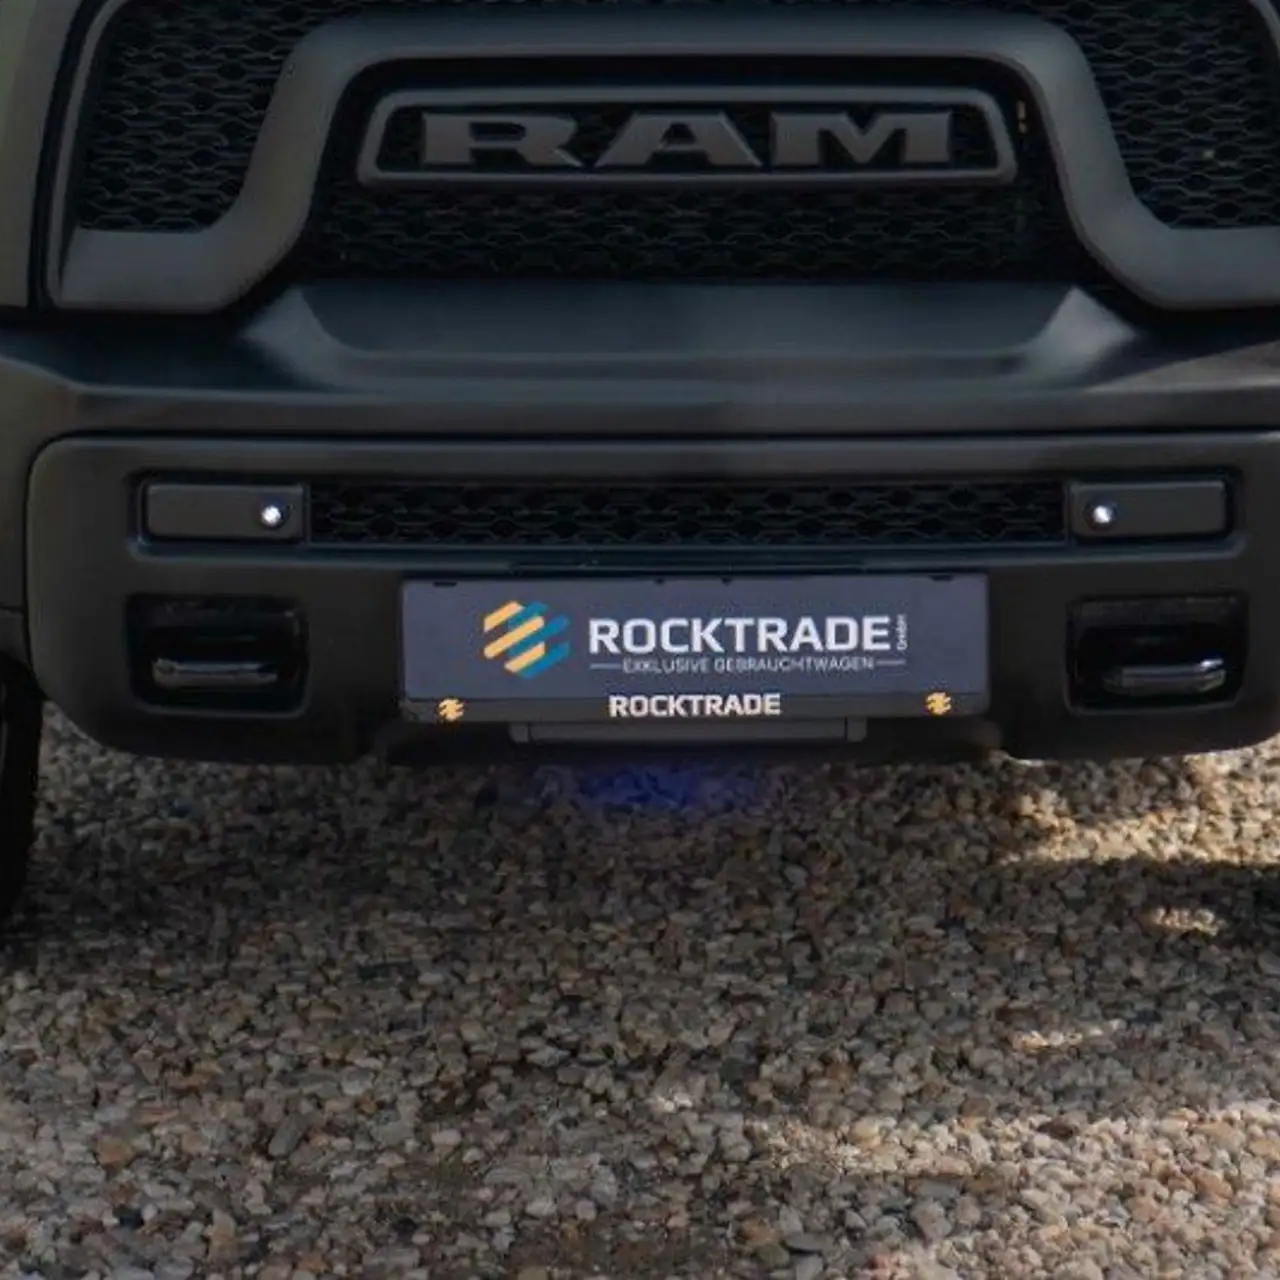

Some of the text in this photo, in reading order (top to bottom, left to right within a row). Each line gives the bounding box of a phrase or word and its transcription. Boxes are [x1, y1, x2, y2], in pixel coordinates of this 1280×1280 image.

[422, 111, 950, 168] RAM
[588, 616, 891, 655] ROCKTRADE
[622, 655, 875, 675] EXKLUSIVE GEBRAUCHTWAGEN
[608, 692, 782, 718] ROCKTRADE
